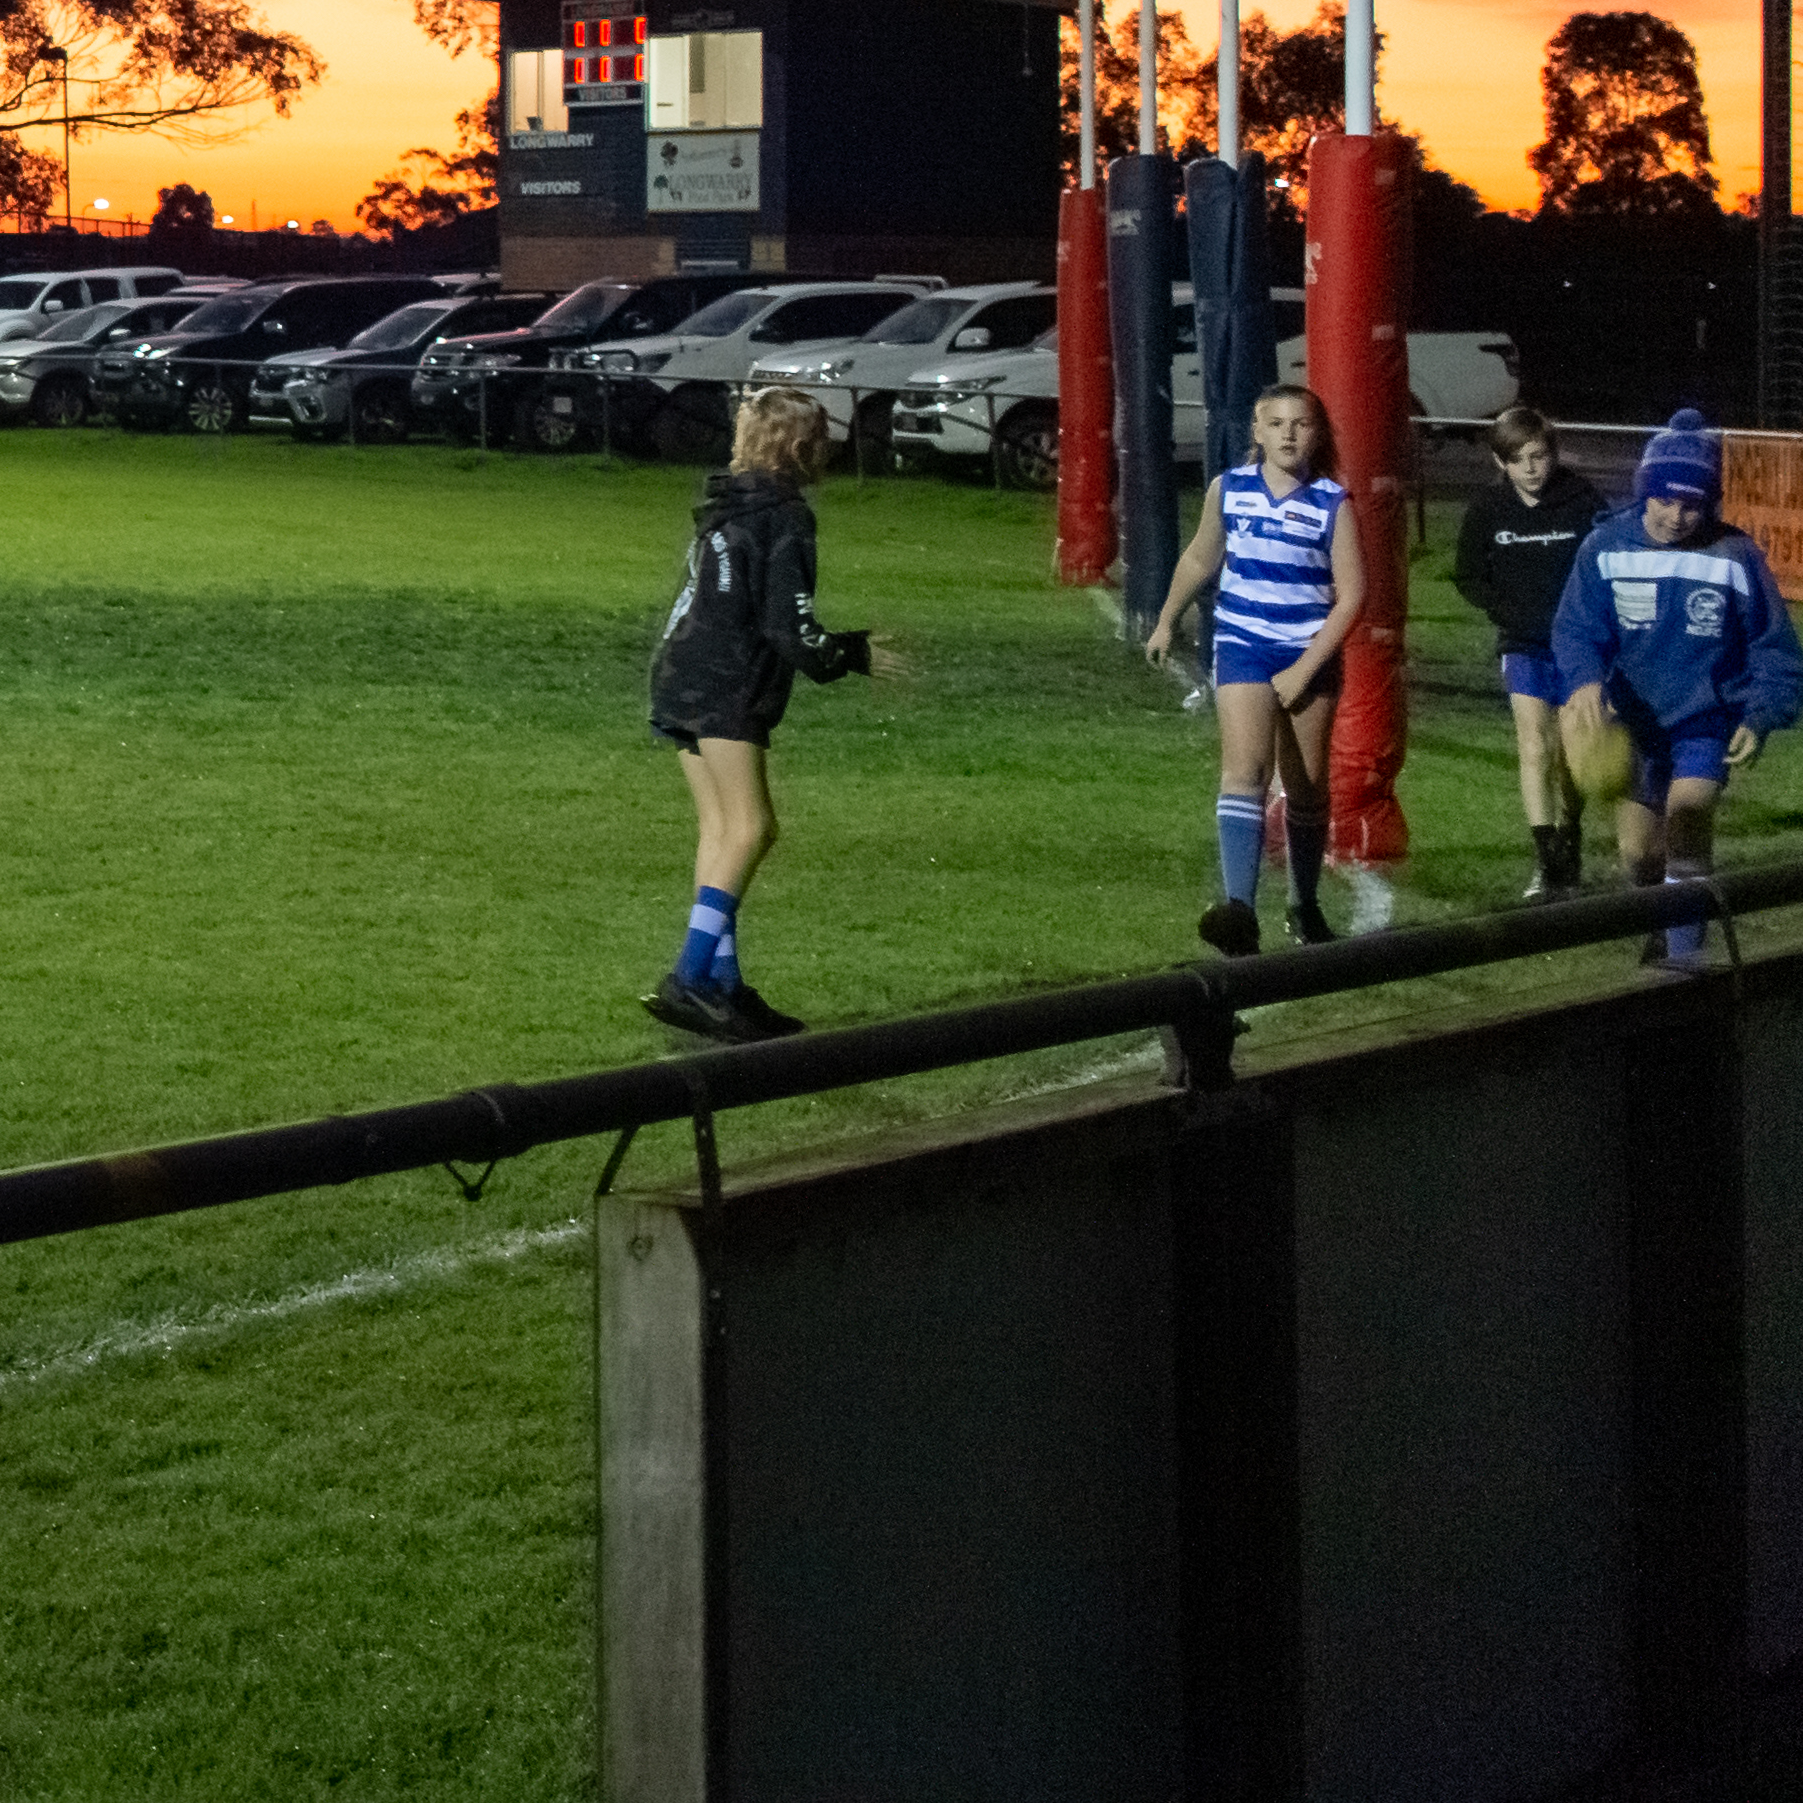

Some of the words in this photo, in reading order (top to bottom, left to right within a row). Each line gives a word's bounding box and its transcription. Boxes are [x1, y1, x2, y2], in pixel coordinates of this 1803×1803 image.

[510, 133, 594, 150] LONGWARRY
[520, 181, 581, 195] VISITORS
[669, 173, 753, 191] LONGWARRY
[1495, 530, 1576, 546] Champion
